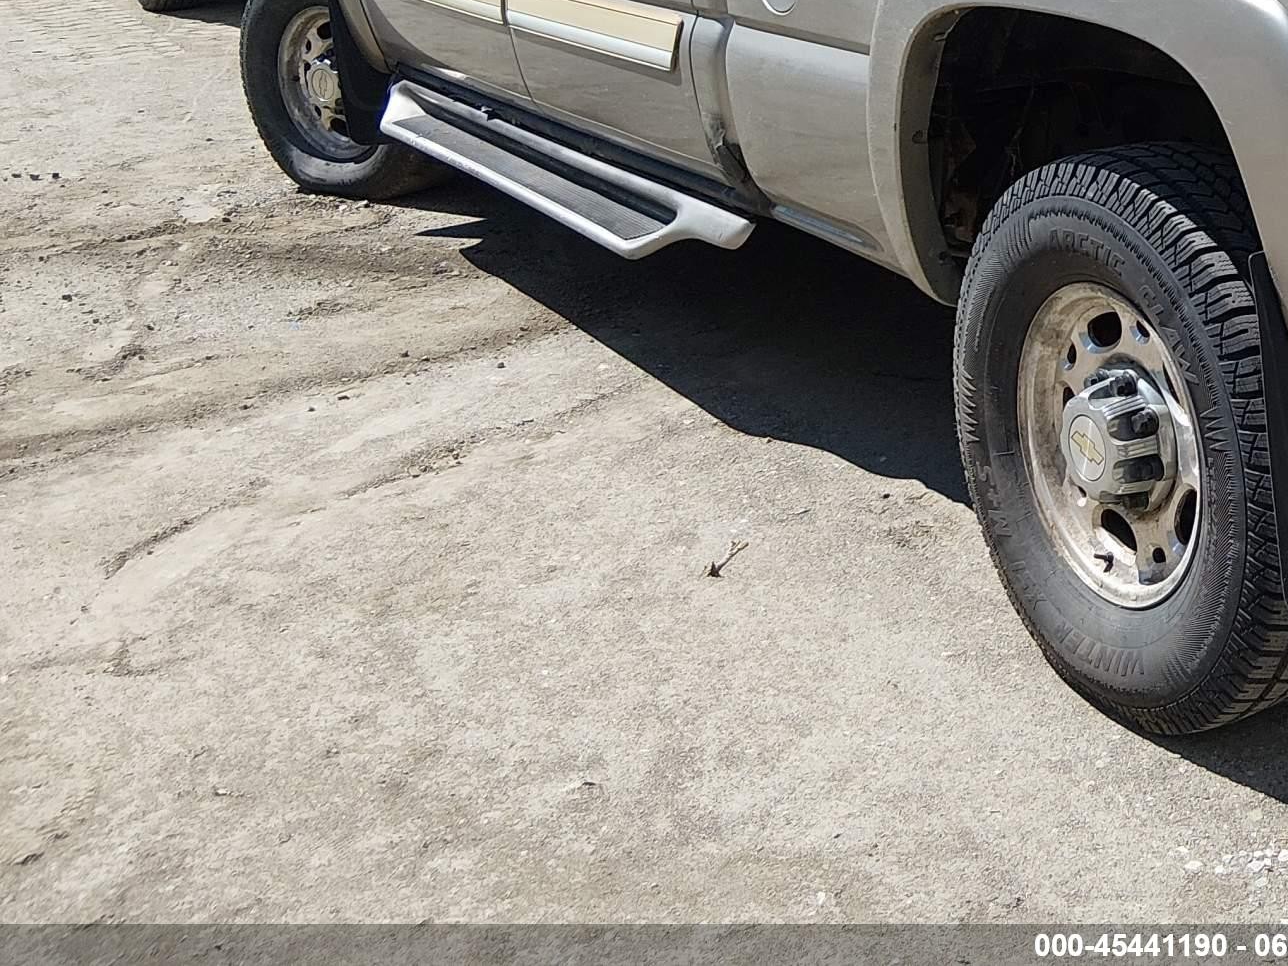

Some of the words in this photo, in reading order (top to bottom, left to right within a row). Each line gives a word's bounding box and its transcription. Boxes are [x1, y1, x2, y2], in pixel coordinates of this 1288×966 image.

[1048, 226, 1126, 279] ARCTIC
[1137, 283, 1201, 386] CLAW
[1053, 623, 1146, 678] WINTER
